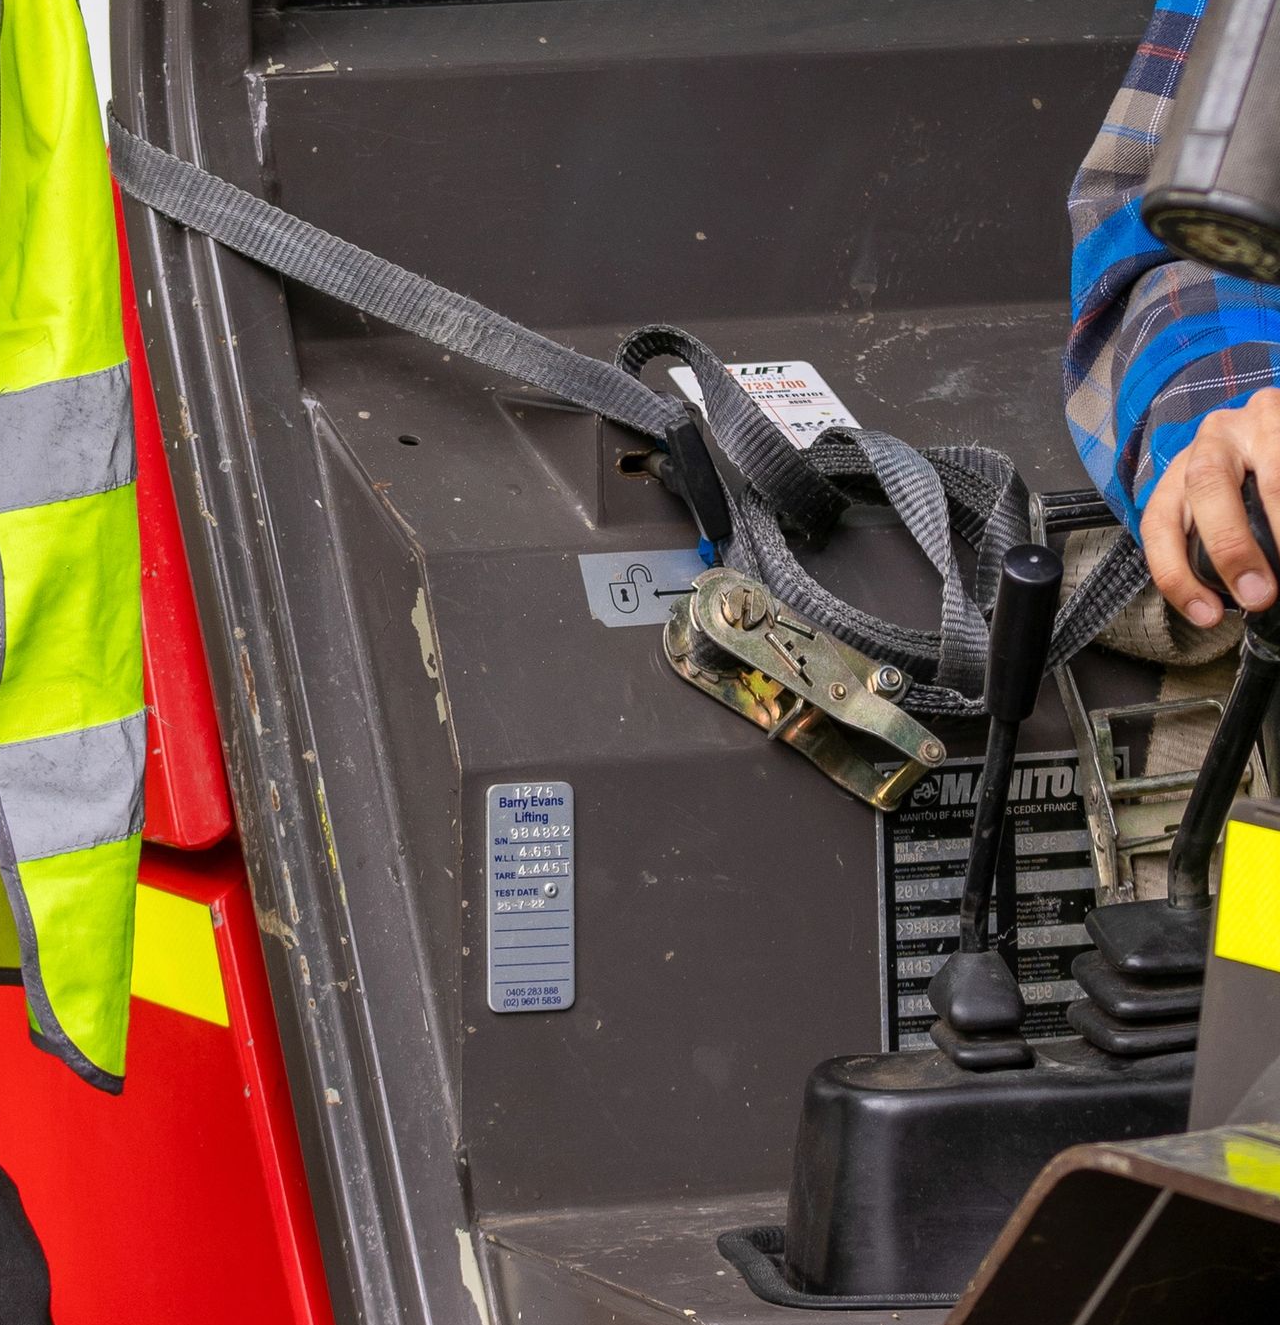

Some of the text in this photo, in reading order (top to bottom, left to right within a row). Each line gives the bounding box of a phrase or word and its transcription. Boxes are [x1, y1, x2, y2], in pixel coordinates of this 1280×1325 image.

[777, 379, 807, 389] 700
[514, 786, 554, 799] 1275
[499, 795, 564, 810] Barry Evans
[515, 812, 549, 824] Lifting
[900, 811, 938, 822] MANITOU
[1014, 804, 1042, 814] CEDEX
[1043, 802, 1078, 812] FRANCE
[494, 825, 571, 845] S/N 984822
[495, 872, 517, 880] TARE
[495, 887, 539, 897] TEST DATE
[506, 986, 559, 997] 0405 283 888
[503, 996, 562, 1008] (02) 9601 5839
